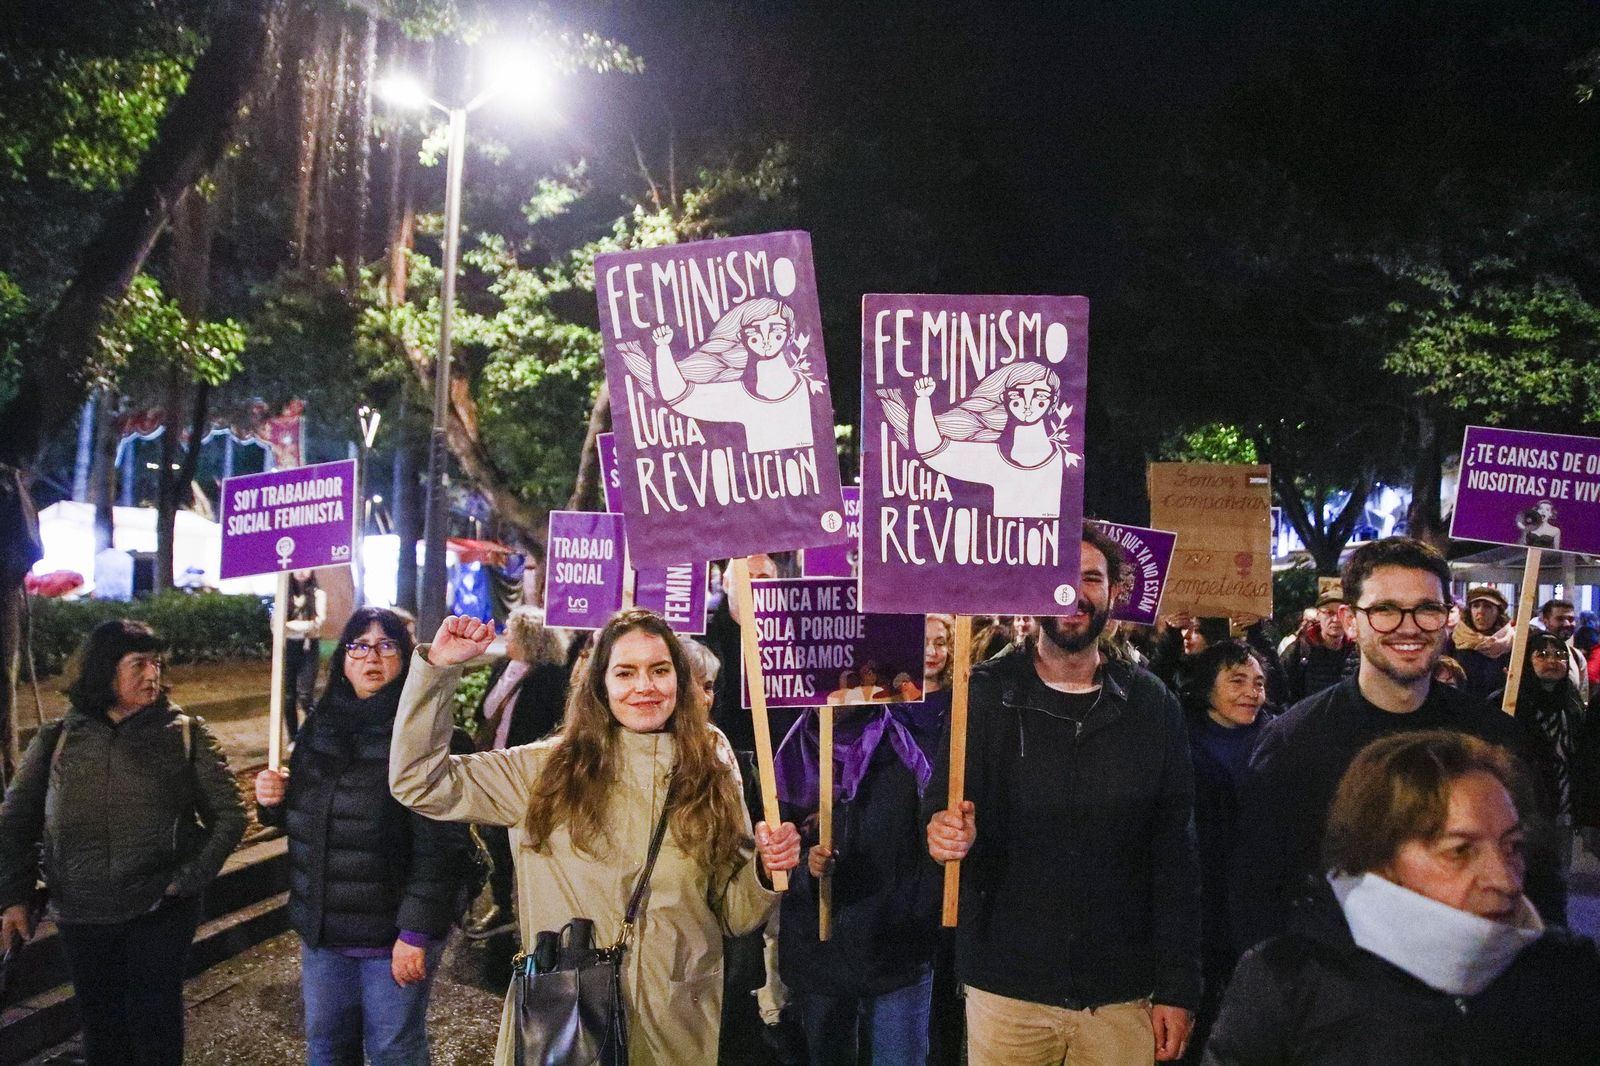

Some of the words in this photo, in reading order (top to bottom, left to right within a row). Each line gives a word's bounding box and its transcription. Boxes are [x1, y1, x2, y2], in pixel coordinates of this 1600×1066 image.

[624, 374, 706, 449] LUCHA
[881, 421, 953, 502] LUCHA
[1467, 443, 1495, 466] ¿TE
[1496, 445, 1560, 471] CANSAS
[1562, 451, 1584, 474] DE
[233, 488, 260, 512] SOY
[260, 476, 343, 507] TRABAJADOR
[1467, 469, 1548, 497] NOSOTRAS
[1550, 478, 1571, 499] DE
[1575, 481, 1600, 503] VIV
[227, 511, 272, 536] SOCIAL
[274, 500, 344, 530] FEMINISTA
[553, 537, 614, 560] TRABAJO
[1121, 531, 1144, 554] QUE
[1136, 546, 1153, 565] YA
[555, 562, 605, 585] SOCIAL
[1142, 562, 1159, 579] NO
[753, 587, 812, 612] NUNCA
[817, 586, 841, 611] ME
[1138, 580, 1159, 613] ESTÁN
[755, 616, 796, 642] SOLA
[801, 615, 866, 640] PORQUE
[759, 641, 855, 670] STÁBAMOS
[763, 674, 816, 698] UNTAS
